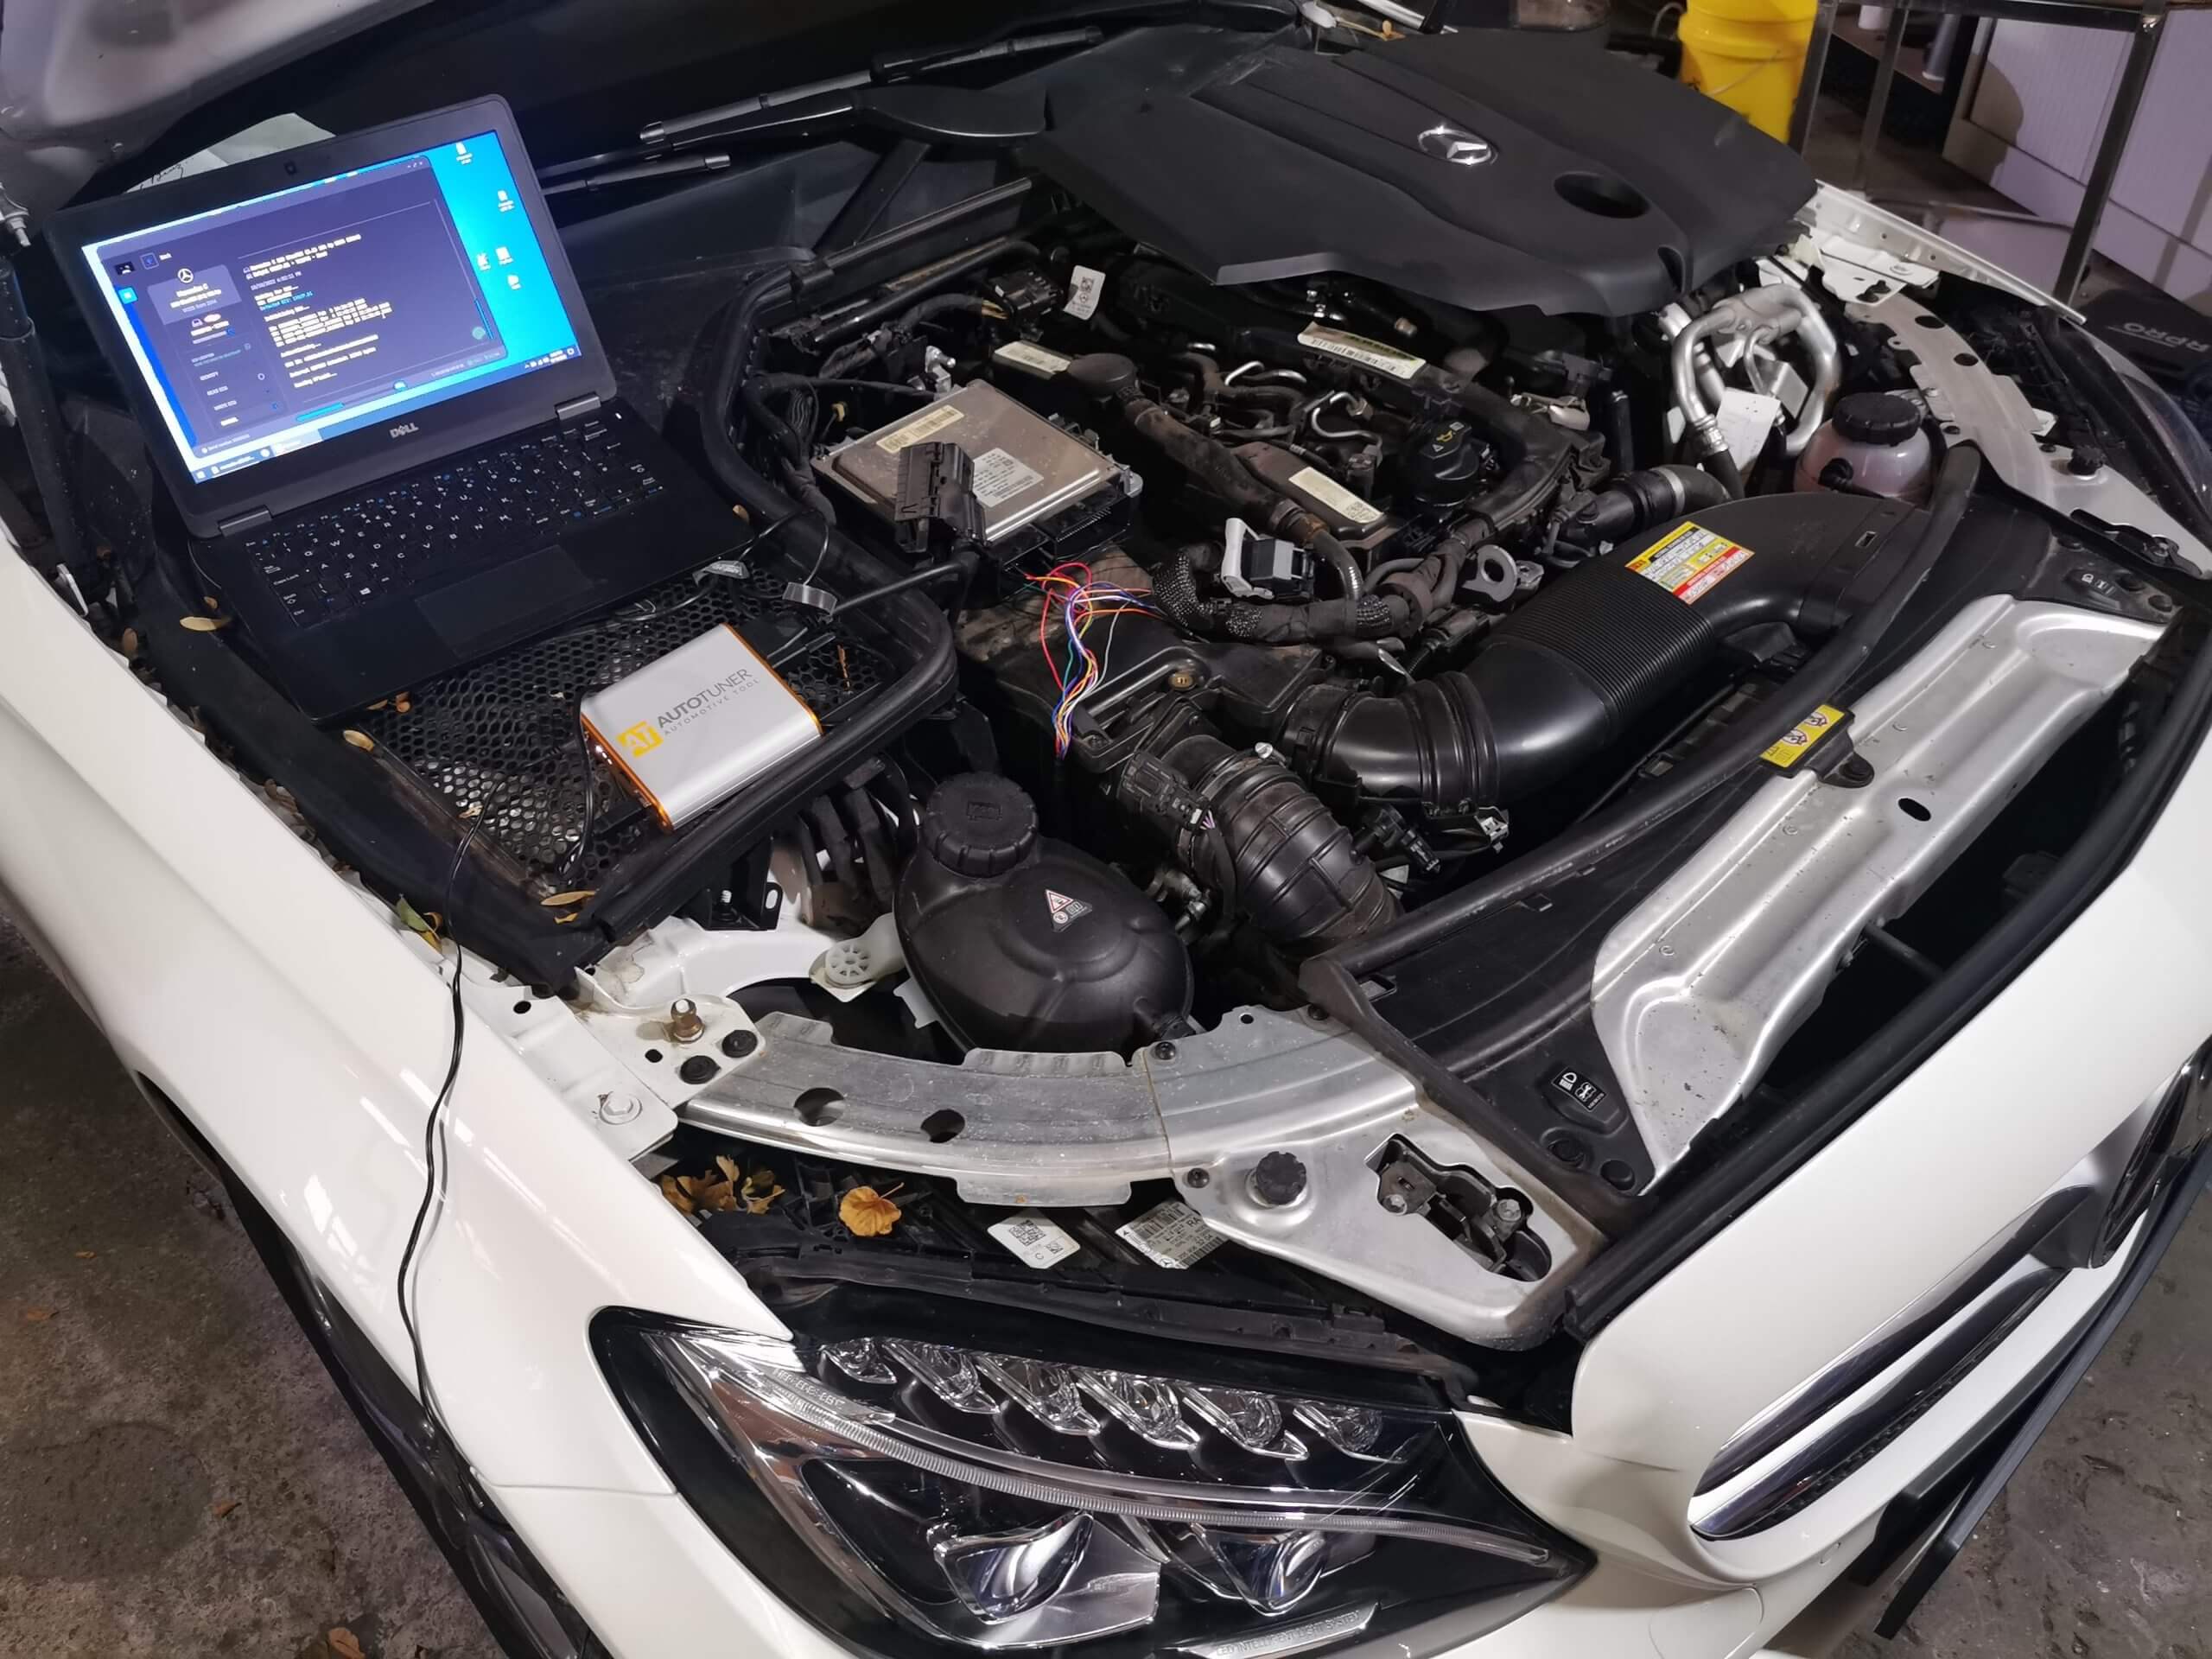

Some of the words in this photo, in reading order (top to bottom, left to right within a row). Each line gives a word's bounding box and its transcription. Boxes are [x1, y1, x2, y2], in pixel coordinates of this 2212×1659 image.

[389, 422, 419, 438] DELL
[657, 669, 753, 728] AUTOTUNER
[664, 695, 730, 735] AUTOMOTIVE
